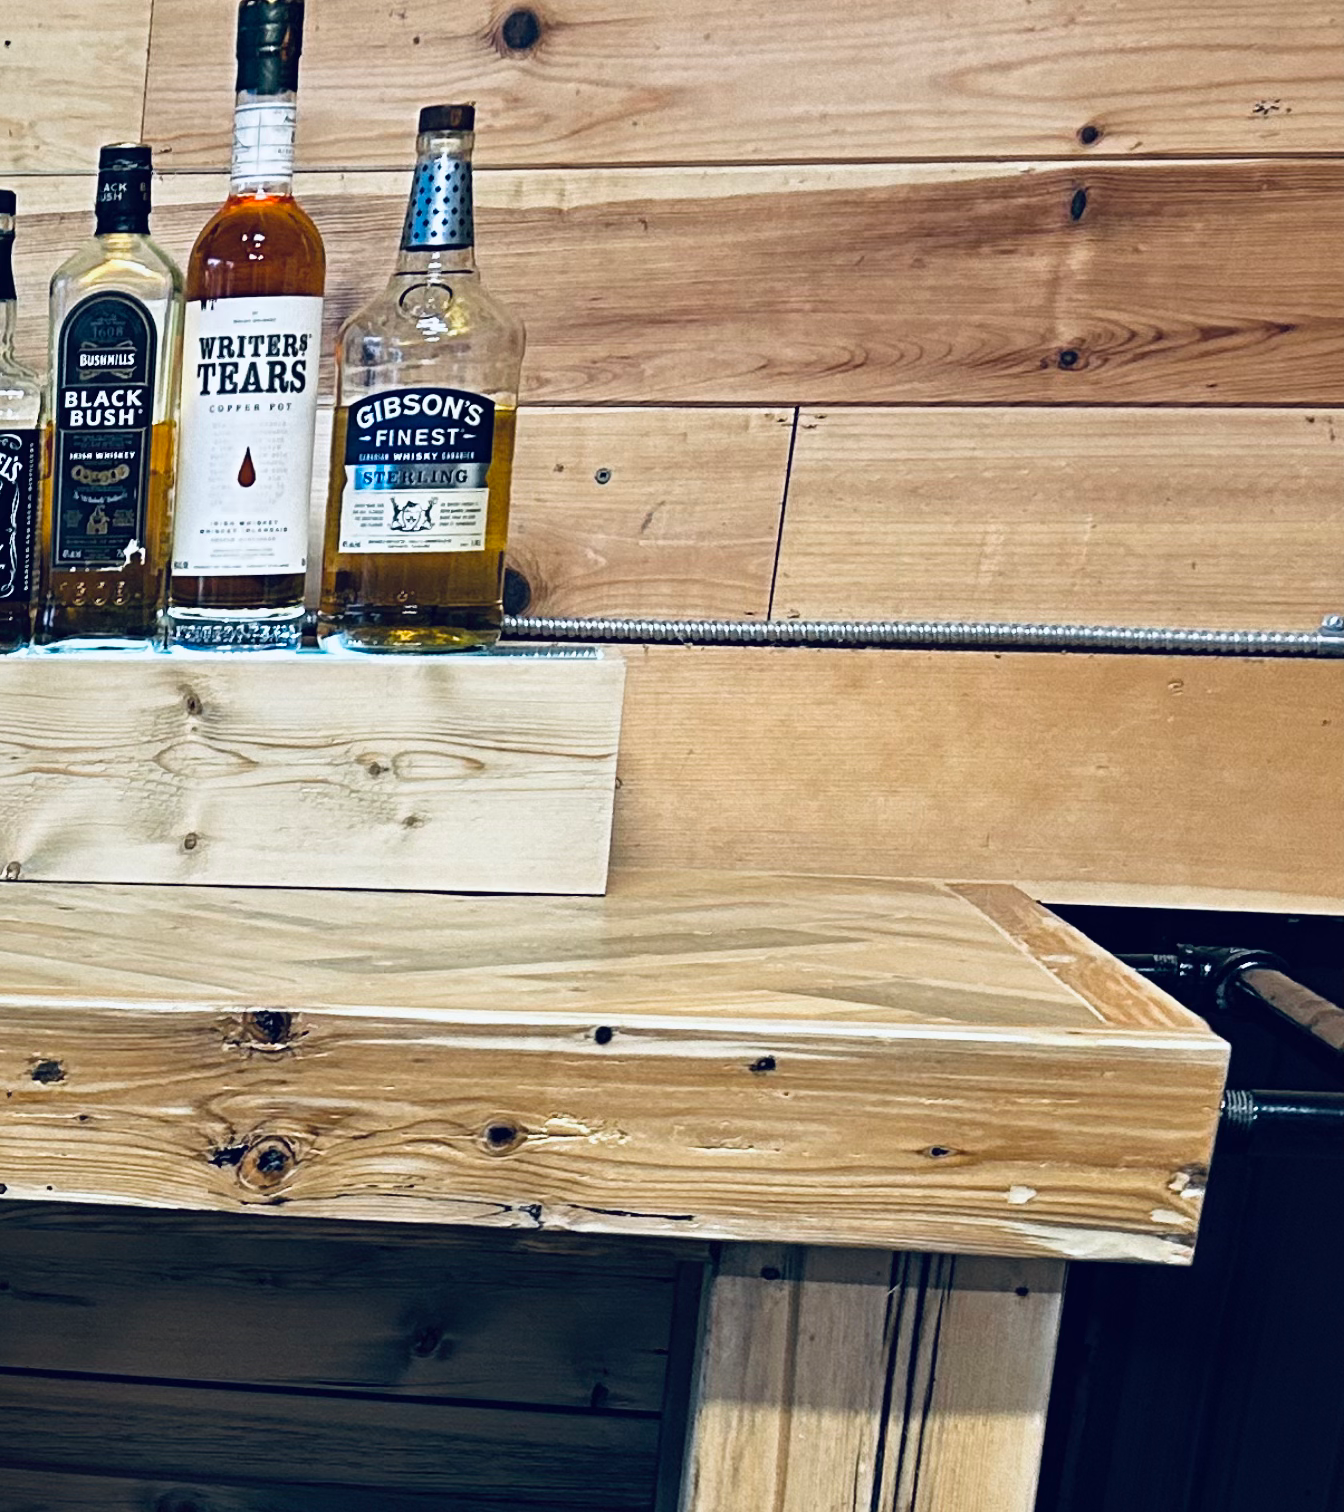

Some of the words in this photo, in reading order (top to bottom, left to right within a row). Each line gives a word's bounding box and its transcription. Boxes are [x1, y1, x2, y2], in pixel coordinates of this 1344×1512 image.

[80, 353, 135, 367] BUSHMILLS
[197, 360, 306, 396] TEARS
[64, 389, 143, 408] BLACK
[209, 403, 260, 413] COPPER
[269, 402, 293, 411] POT
[69, 409, 135, 427] BUSH
[356, 394, 484, 429] GIBSON'S
[375, 428, 459, 447] FINEST
[393, 452, 438, 461] WHISKY
[363, 469, 468, 485] STERLING
